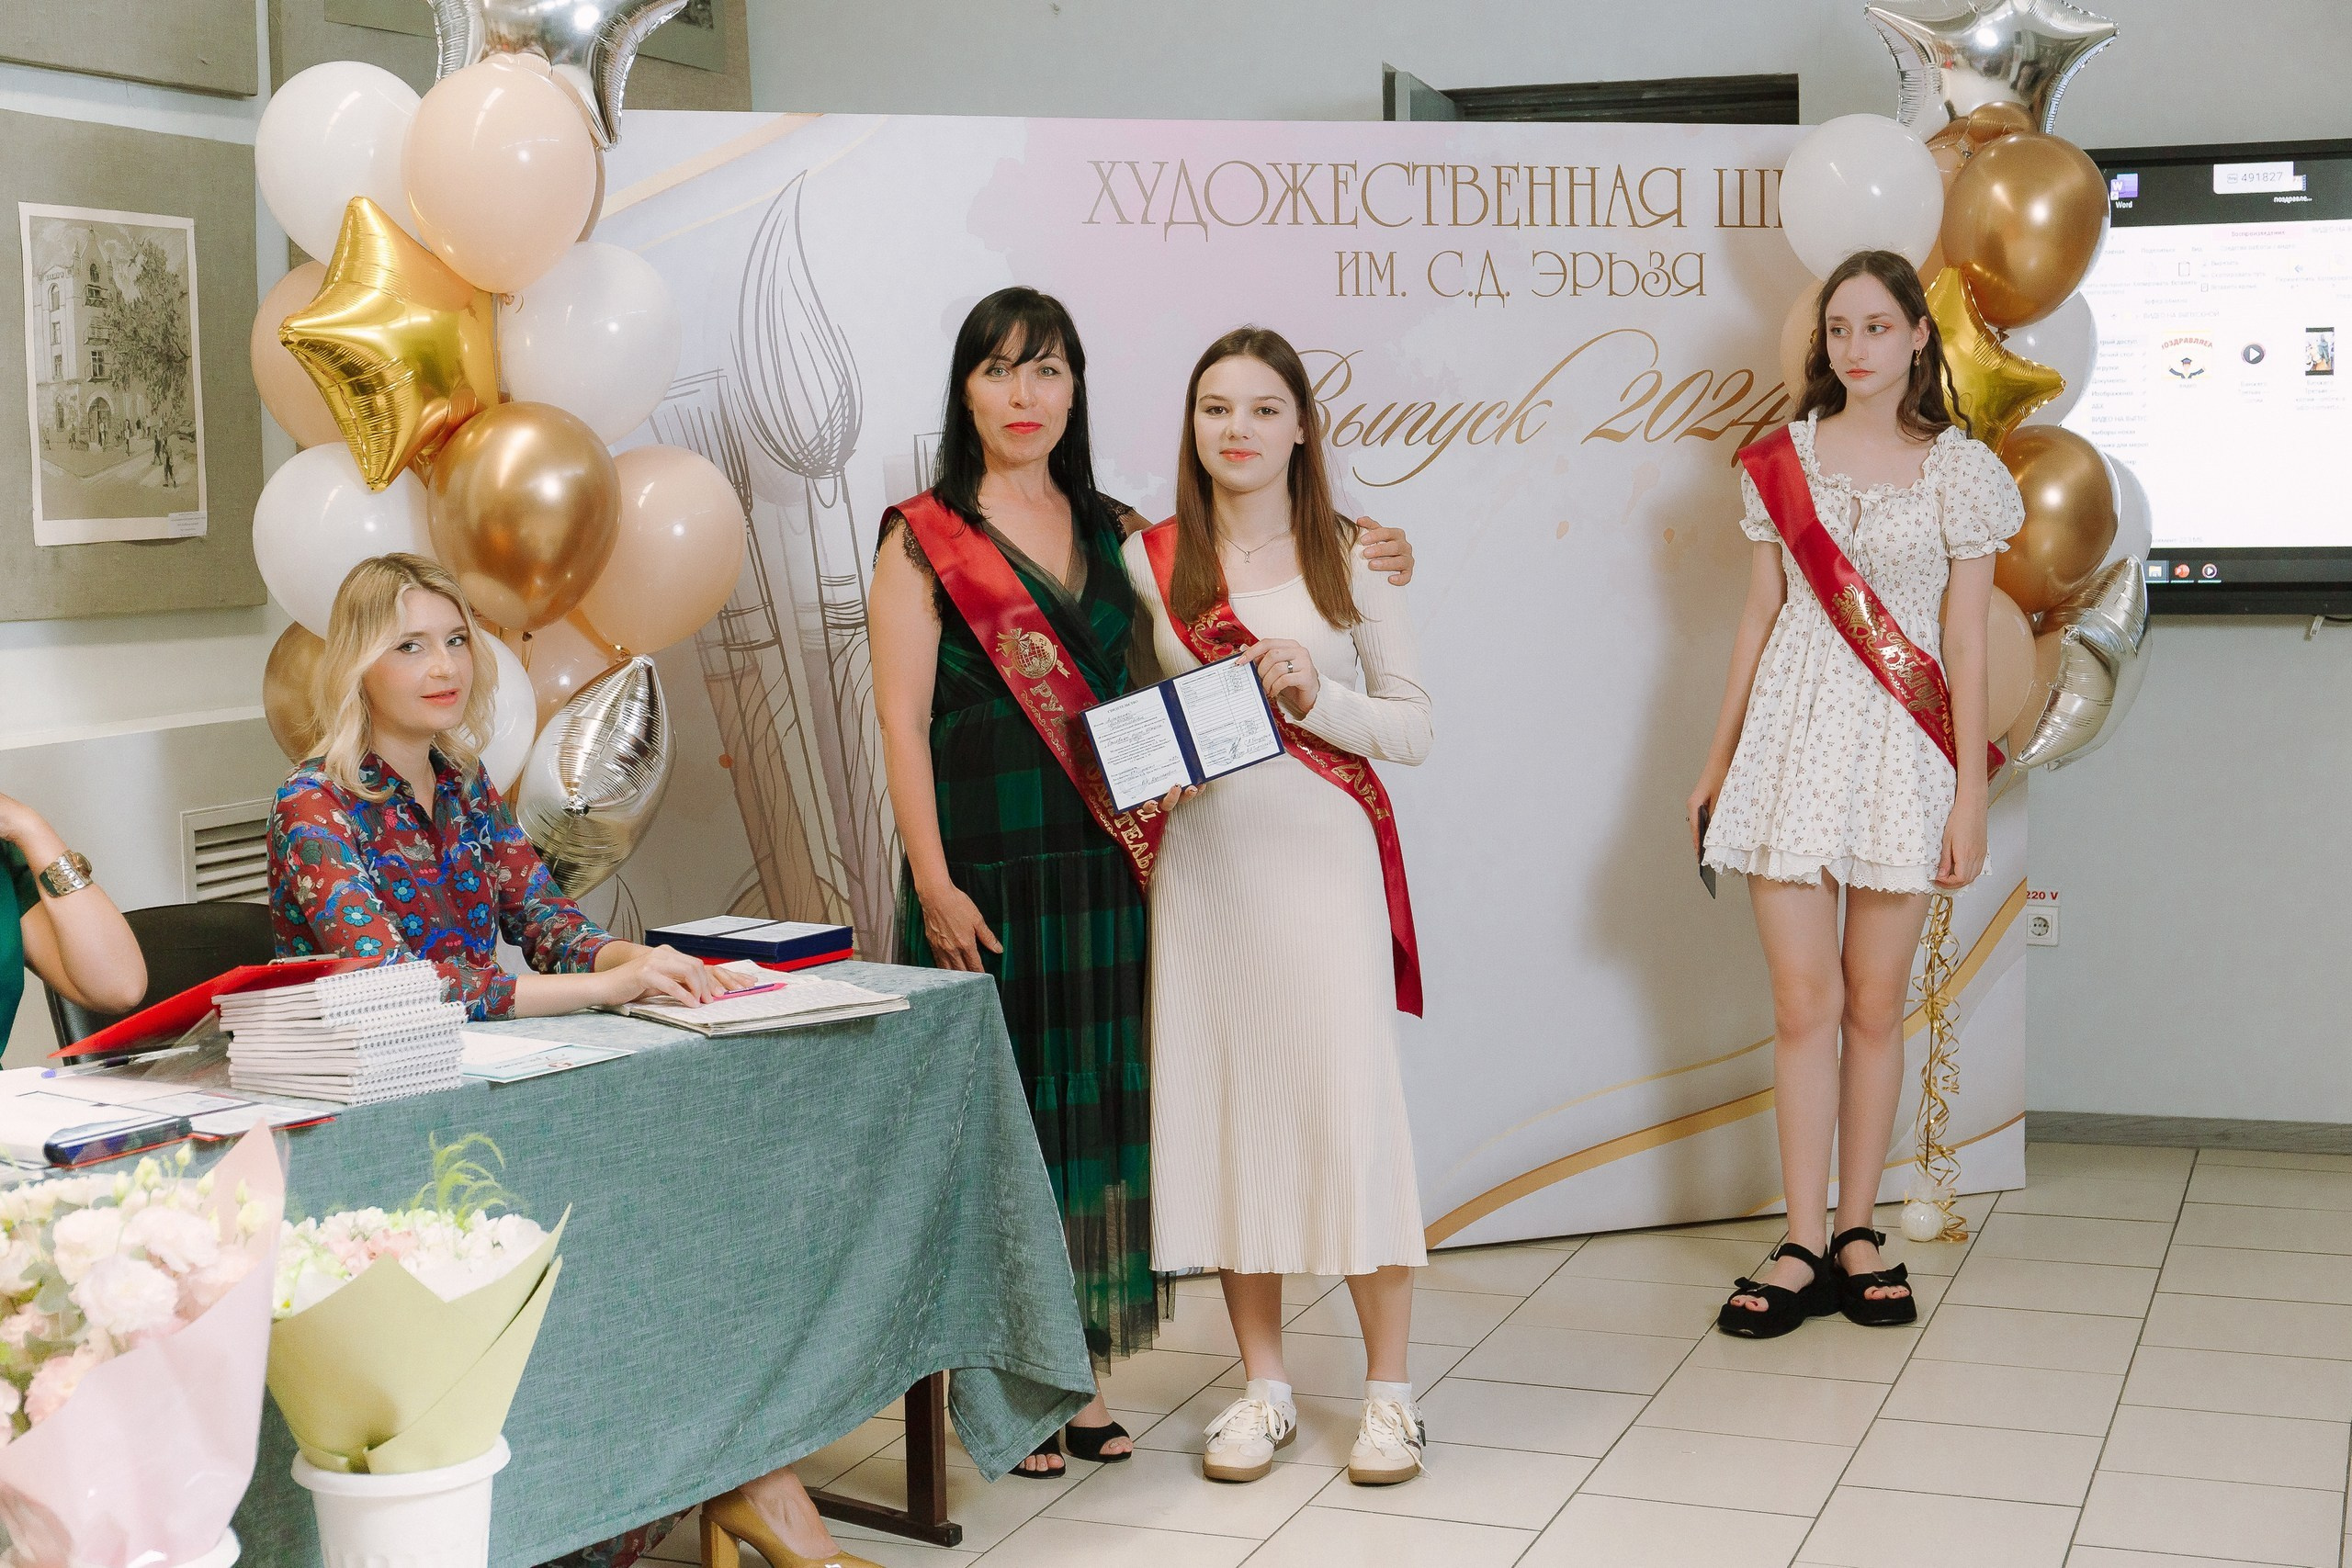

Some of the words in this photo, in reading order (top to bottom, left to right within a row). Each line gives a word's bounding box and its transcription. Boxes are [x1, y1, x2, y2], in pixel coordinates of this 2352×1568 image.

[2241, 172, 2283, 183] 491827
[1081, 158, 1687, 243] ХУДОЖЕСТВЕННАЯ
[1713, 168, 1784, 228] Ш
[2115, 200, 2133, 209] Word
[1335, 250, 1408, 298] ИМ.
[1531, 251, 1707, 298] ЭРЬЗЯ
[1580, 367, 1788, 468] 2024
[2050, 891, 2059, 901] V
